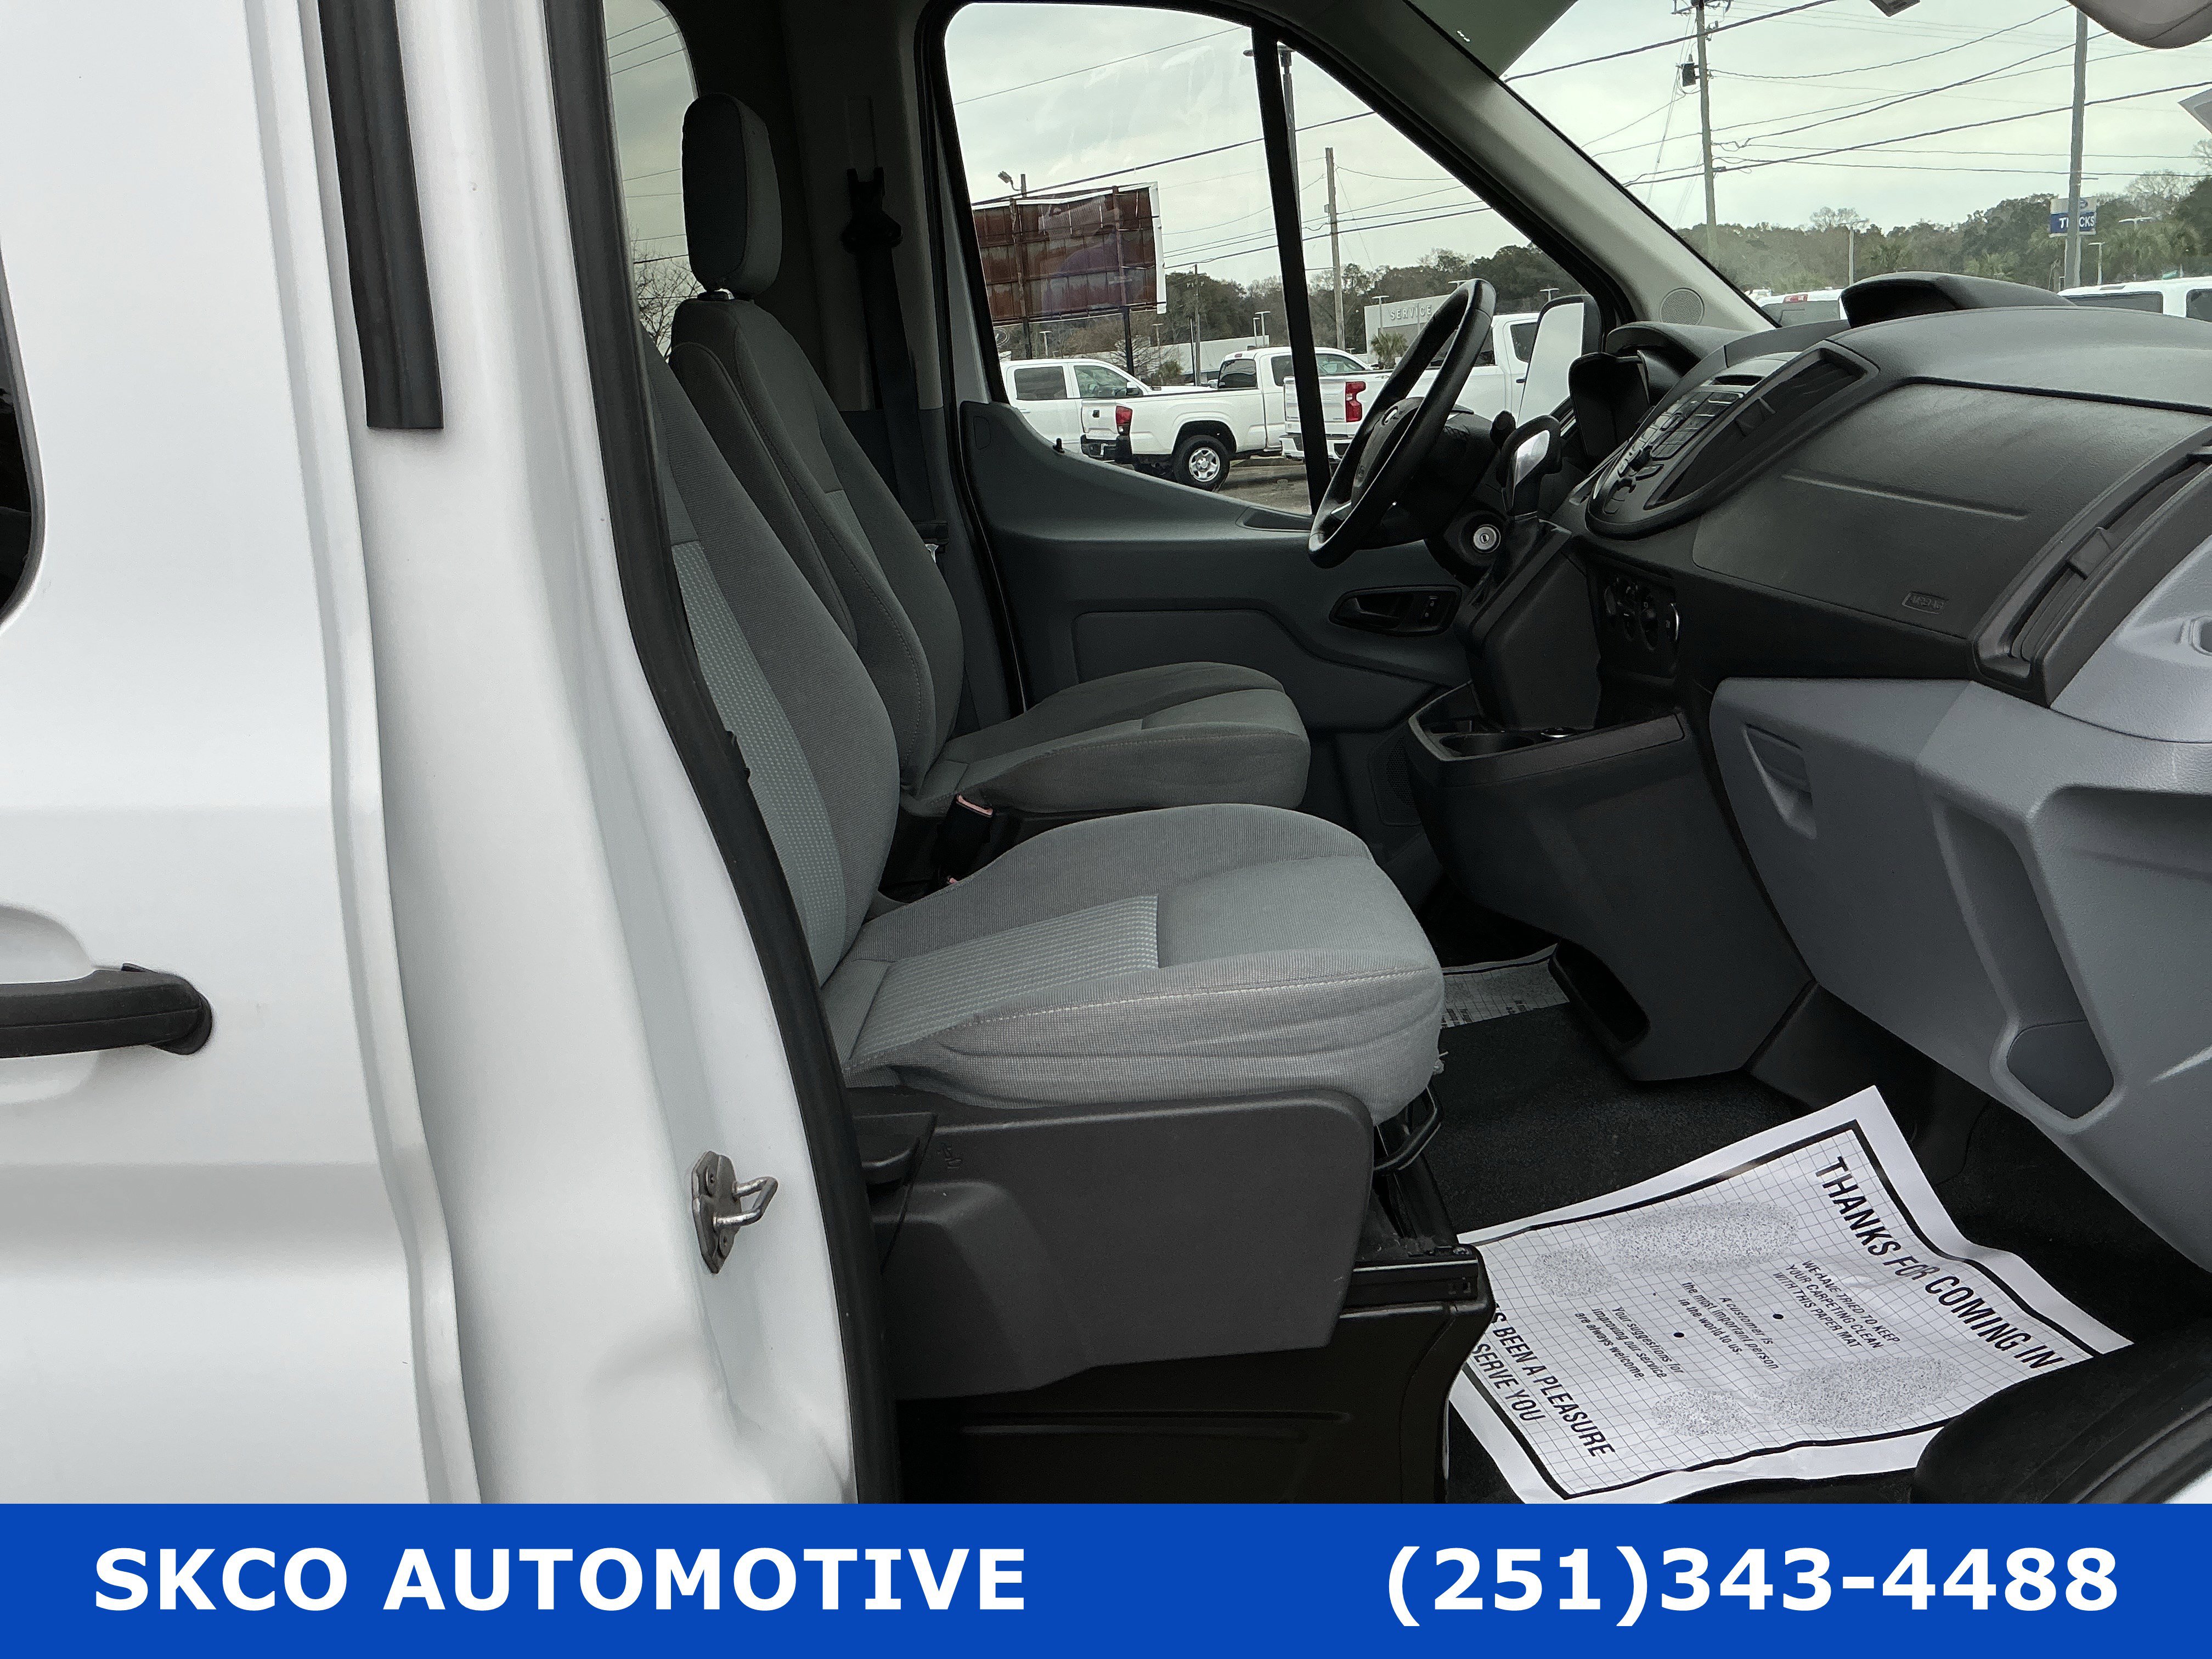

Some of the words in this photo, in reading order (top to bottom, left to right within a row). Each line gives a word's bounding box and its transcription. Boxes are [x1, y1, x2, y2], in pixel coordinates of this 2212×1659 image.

[2059, 216, 2095, 228] TCKS
[1390, 305, 1432, 320] SERVICE
[1815, 1156, 1901, 1256] THANKS
[1882, 1256, 1940, 1280] FOR
[1925, 1276, 2031, 1351] COMING
[2013, 1345, 2064, 1369] IN
[1575, 1312, 1591, 1323] are
[1586, 1324, 1613, 1346] always
[1678, 1298, 1690, 1306] in
[1686, 1306, 1702, 1317] the
[1699, 1317, 1726, 1337] world
[1728, 1344, 1743, 1355] us.
[1682, 1282, 1698, 1294] the
[1694, 1295, 1718, 1310] most
[1712, 1308, 1754, 1342] important
[1745, 1343, 1779, 1369] person
[1726, 1304, 1765, 1336] customer
[1773, 1272, 1798, 1289] WITH
[1793, 1289, 1816, 1308] THIS
[1810, 1308, 1843, 1331] PAPER
[1837, 1331, 1863, 1347] MAT
[1786, 1264, 1812, 1283] YOUR
[1806, 1284, 1856, 1324] CARPETING
[1850, 1324, 1884, 1348] CLEAN
[1802, 1260, 1821, 1273] WE
[1815, 1273, 1842, 1293] HAVE
[1836, 1293, 1865, 1314] TRIED
[1861, 1314, 1878, 1325] TO
[1872, 1325, 1901, 1342] KEEP
[1492, 1327, 1538, 1363] BEEN
[1521, 1365, 1547, 1376] A
[1592, 1308, 1629, 1340] improving
[1624, 1341, 1642, 1351] our
[1636, 1352, 1668, 1378] service
[1612, 1307, 1632, 1322] Your
[1627, 1323, 1672, 1362] suggestions
[1667, 1363, 1685, 1373] for
[1471, 1344, 1520, 1390] SERVE
[1505, 1389, 1547, 1421] YOU
[1533, 1375, 1616, 1457] PLEASURE
